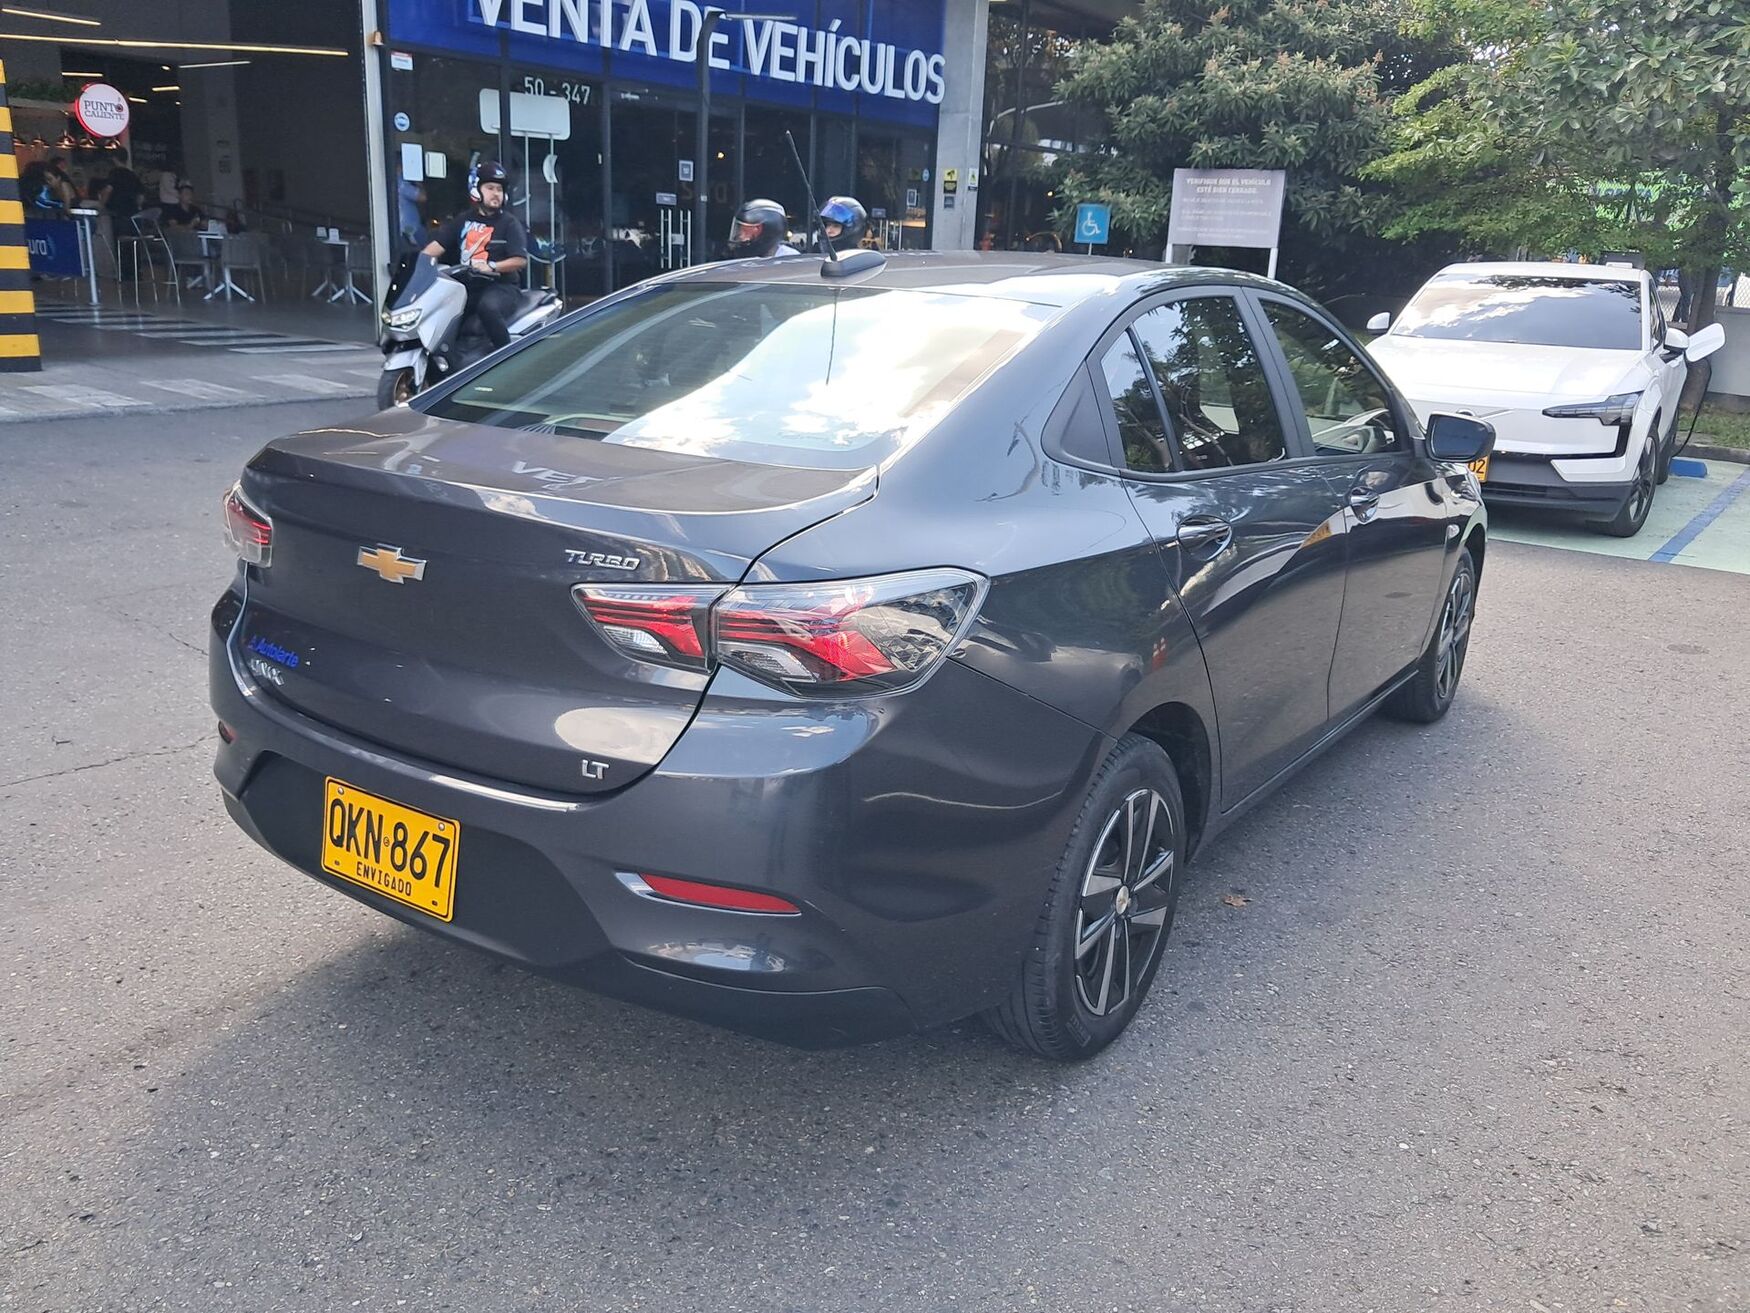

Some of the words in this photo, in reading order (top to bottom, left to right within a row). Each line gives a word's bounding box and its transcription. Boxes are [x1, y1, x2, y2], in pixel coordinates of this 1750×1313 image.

[669, 0, 730, 70] DE
[743, 18, 946, 104] VEHÍCULOS
[562, 82, 591, 105] 347
[84, 98, 124, 113] PUNTO
[84, 110, 125, 121] CALIENTE
[565, 549, 640, 571] TURBO
[582, 759, 610, 780] LT
[356, 861, 412, 897] ENVIGADO
